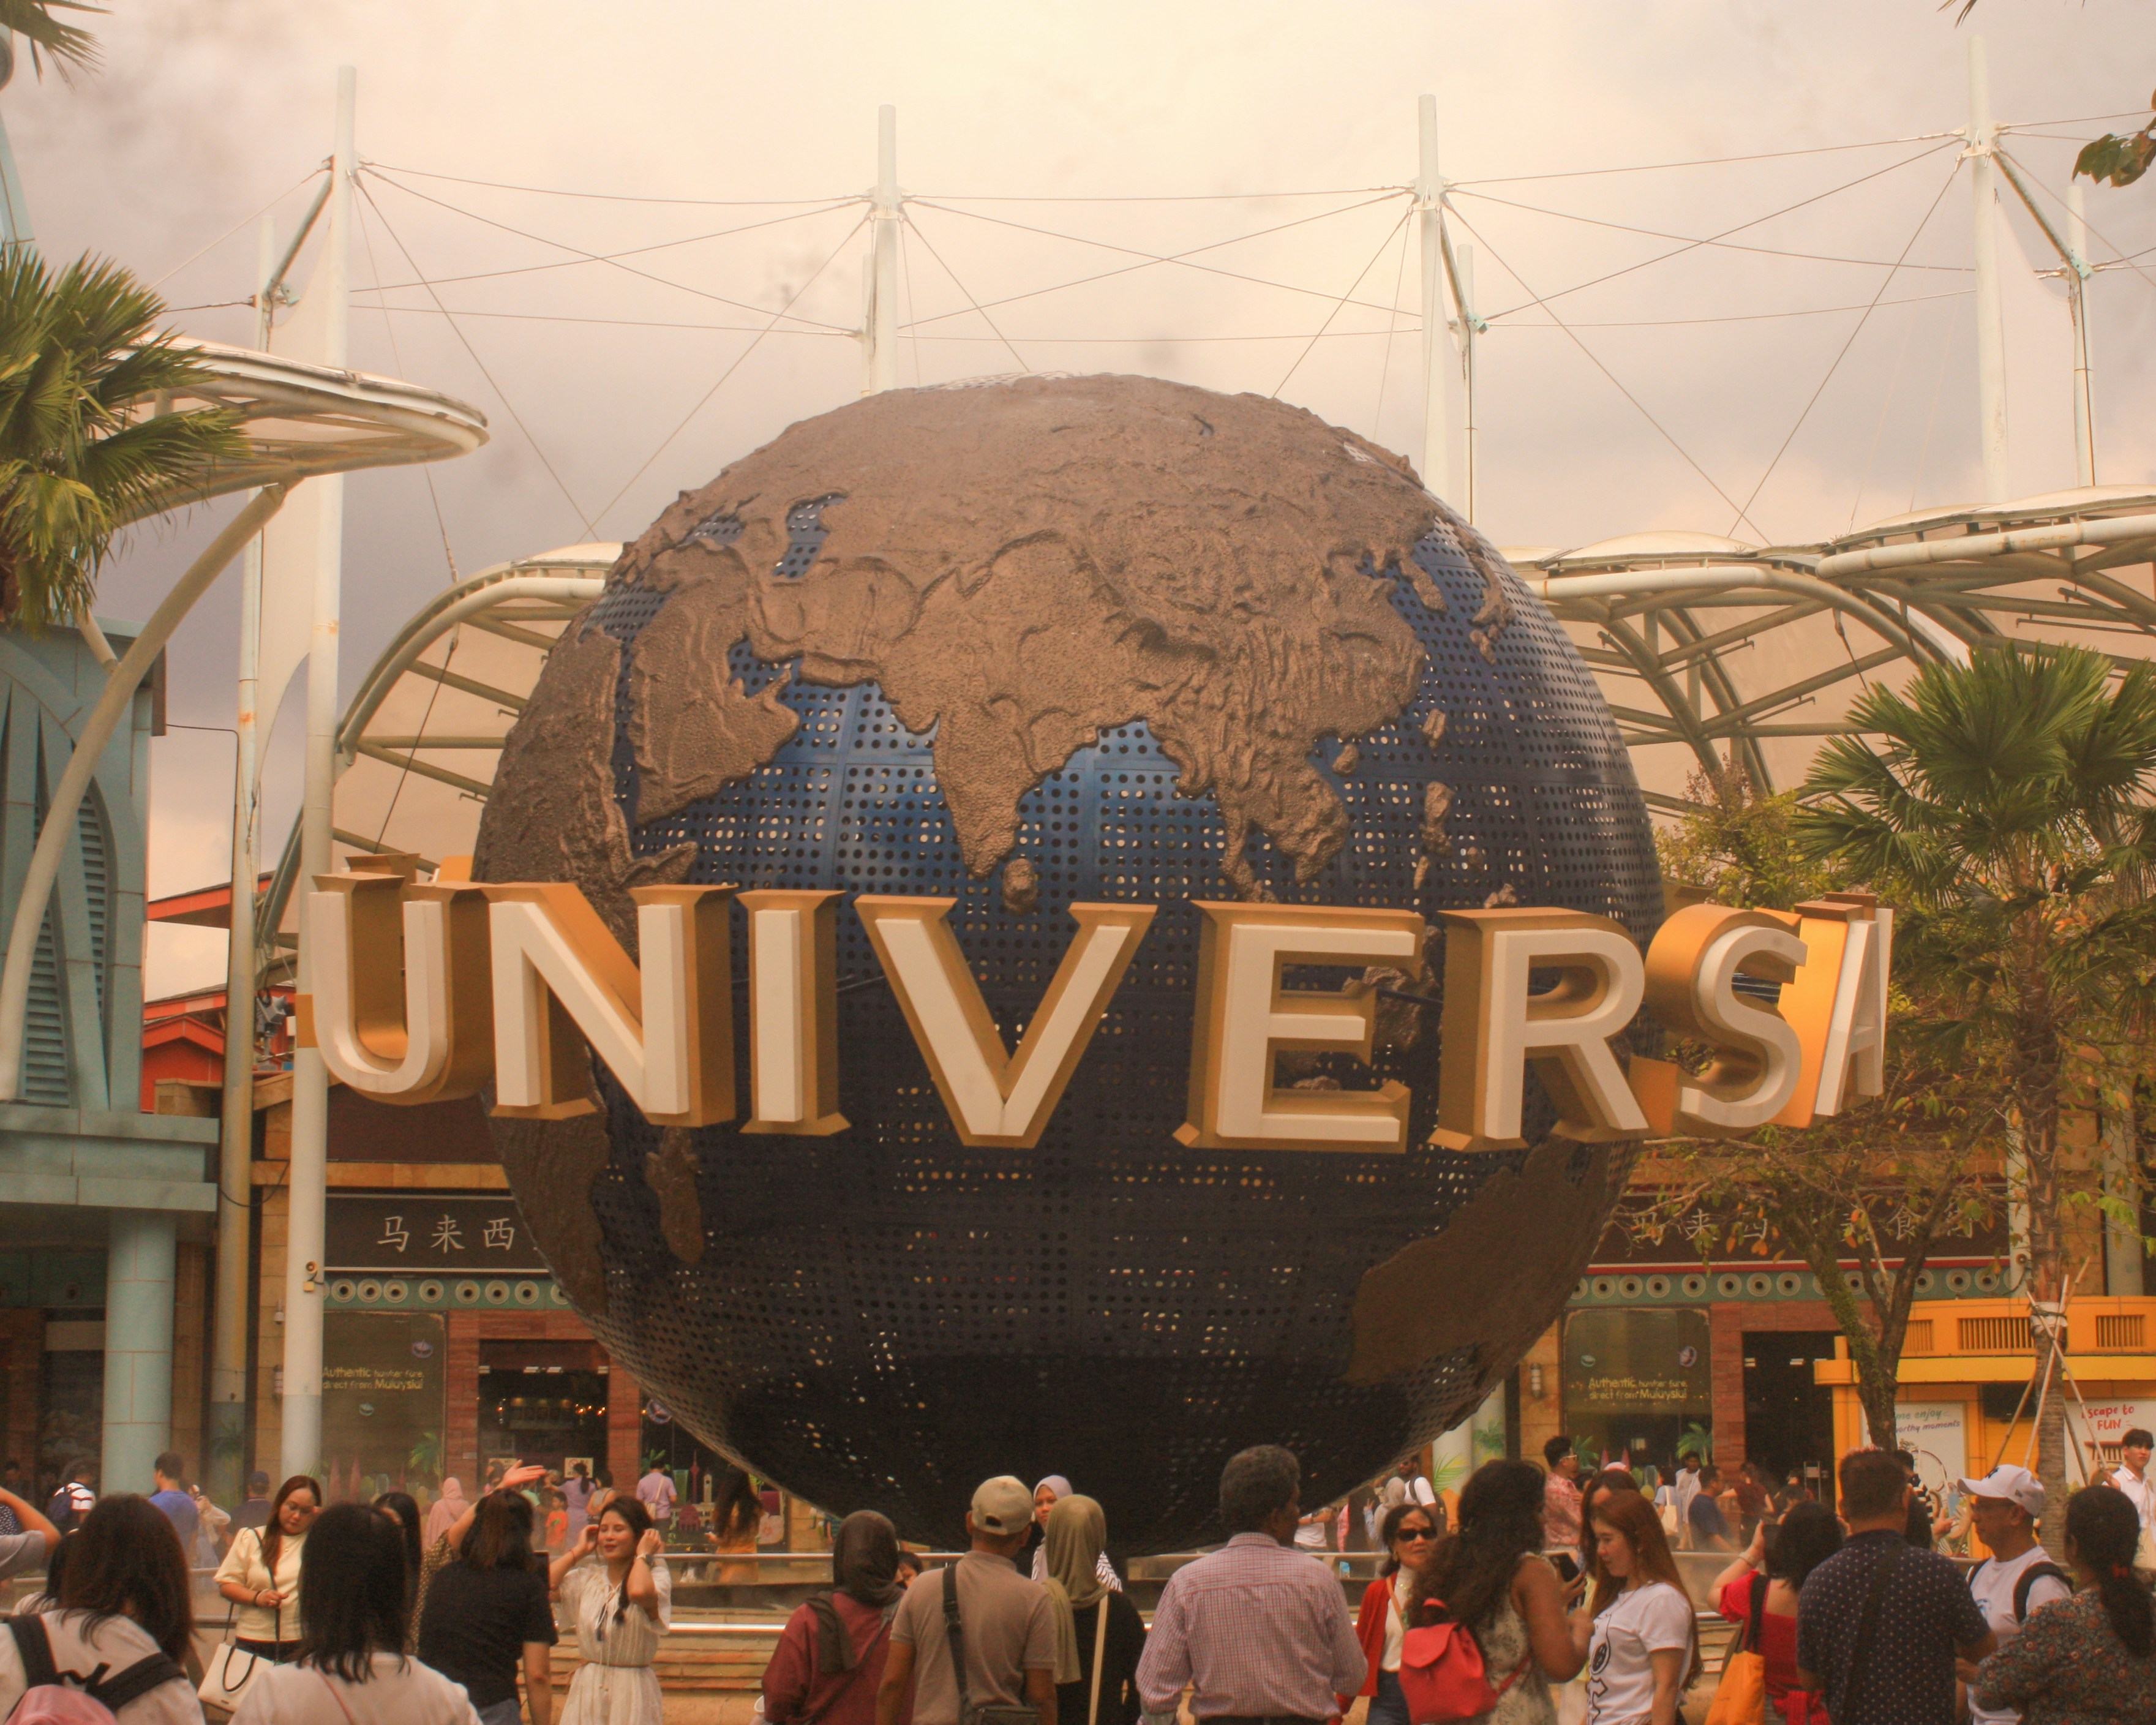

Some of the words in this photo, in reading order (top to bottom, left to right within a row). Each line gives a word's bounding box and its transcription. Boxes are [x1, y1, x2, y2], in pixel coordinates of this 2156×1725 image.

[305, 871, 1893, 1154] UNIVERSA
[323, 1366, 371, 1377] Authentic
[350, 1380, 371, 1389] from
[1589, 1377, 1637, 1388] Authentic
[1616, 1390, 1637, 1399] from
[1915, 1408, 1942, 1421] enjoy
[2123, 1404, 2135, 1415] to
[1922, 1420, 1961, 1430] moments
[2097, 1419, 2121, 1430] FUN
